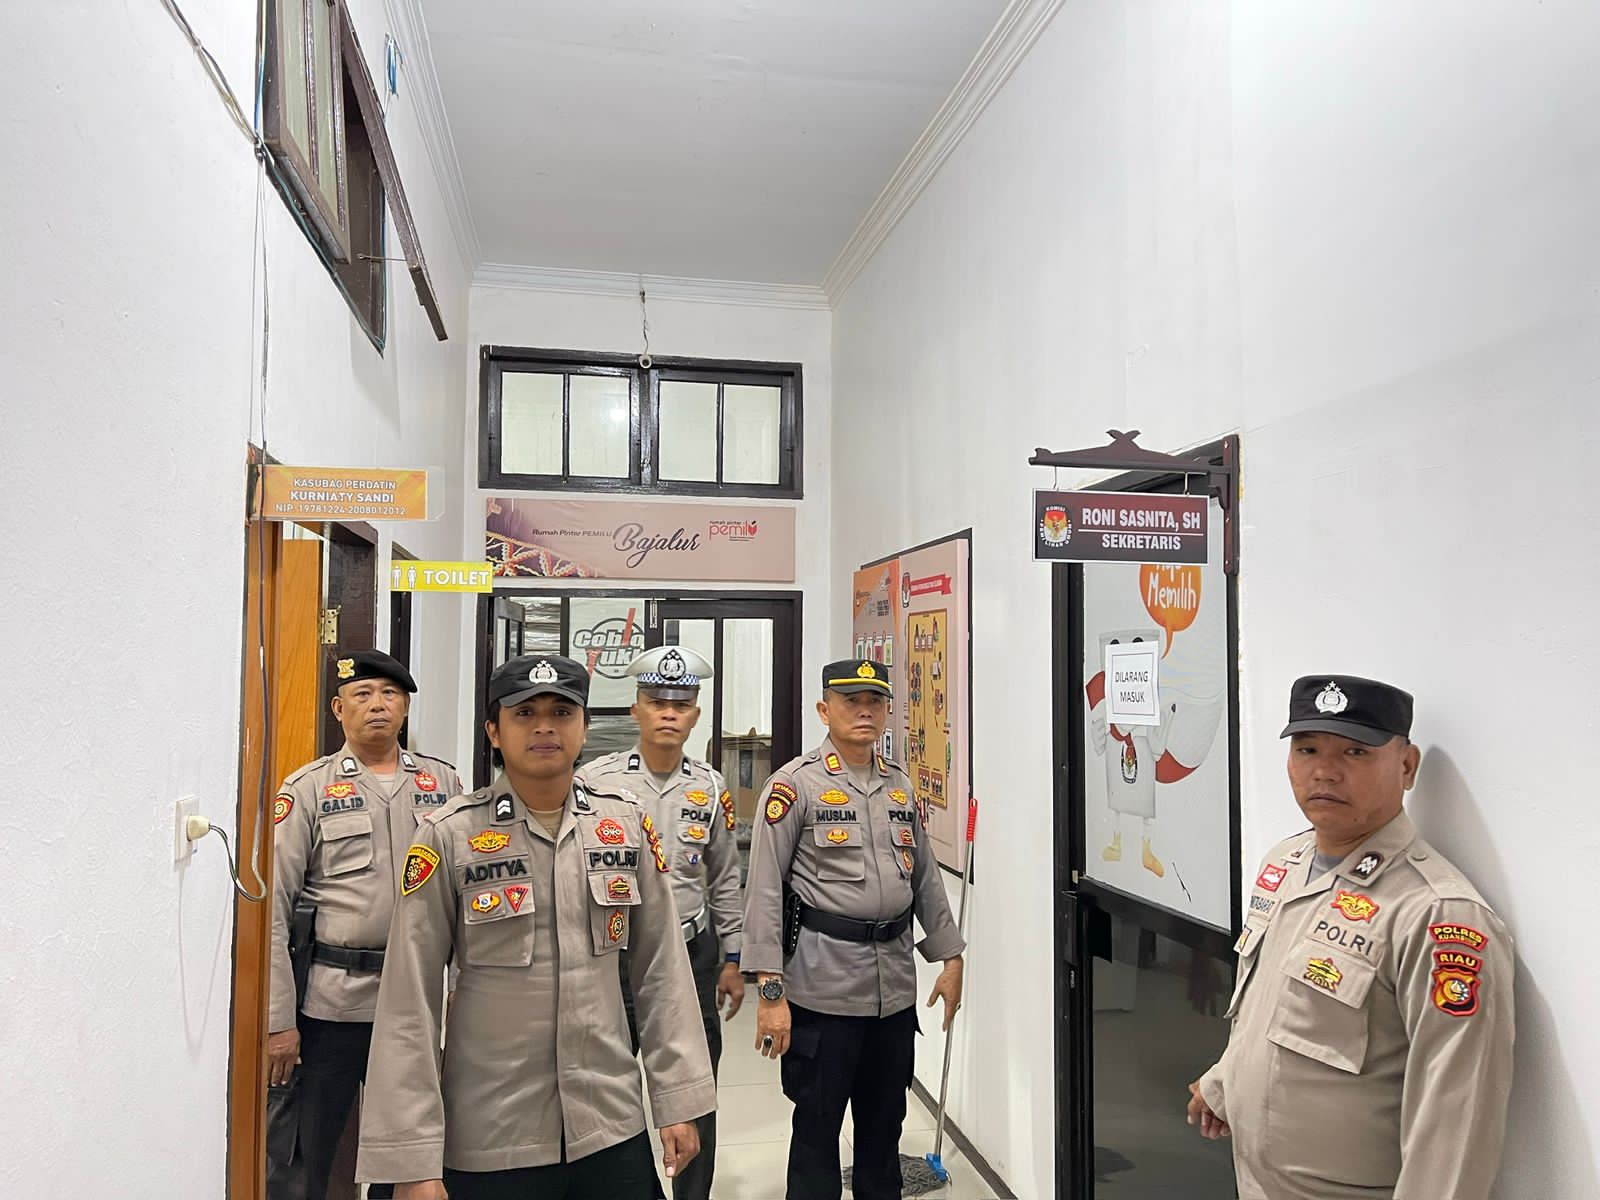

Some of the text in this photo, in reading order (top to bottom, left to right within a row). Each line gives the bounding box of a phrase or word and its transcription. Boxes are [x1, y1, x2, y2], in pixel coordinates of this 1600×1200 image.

[293, 478, 396, 490] KASUBAG PERDATIN
[290, 491, 394, 503] KURNIATY SANDI
[1082, 507, 1201, 533] RONI SASNITA, SH
[612, 522, 700, 569] Bajalur
[1101, 533, 1182, 551] SEKRETARIS
[424, 569, 490, 586] TOILET
[1147, 571, 1197, 612] Memilih
[1114, 670, 1149, 683] DILARANG
[1119, 691, 1145, 704] MASUK
[815, 809, 857, 823] MUSLIM
[589, 850, 638, 868] POLRI
[463, 858, 527, 884] ADITYA
[1314, 919, 1374, 957] POLRI
[1433, 926, 1483, 944] POLRES
[1439, 953, 1476, 967] RIAU
